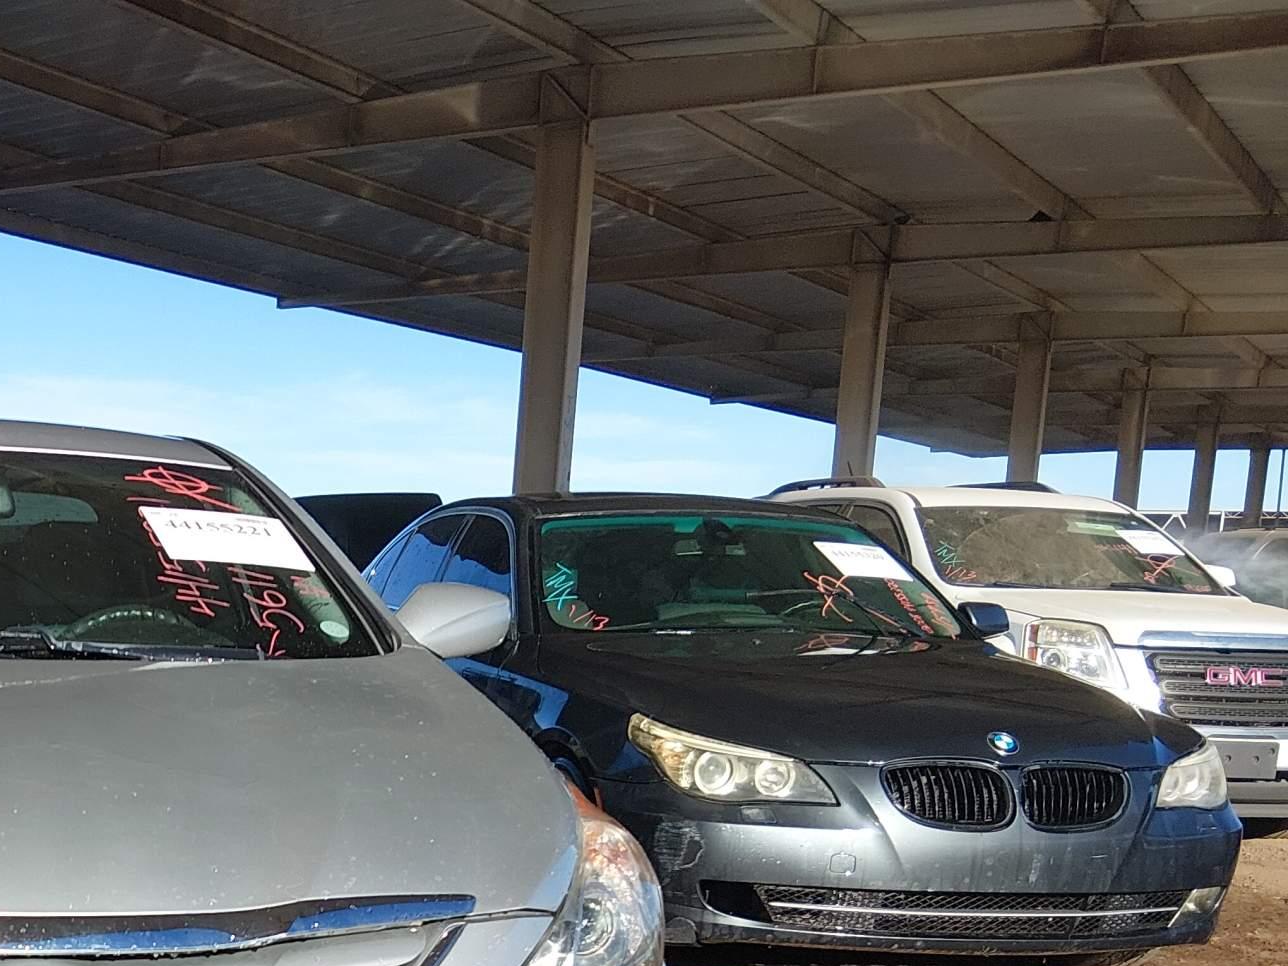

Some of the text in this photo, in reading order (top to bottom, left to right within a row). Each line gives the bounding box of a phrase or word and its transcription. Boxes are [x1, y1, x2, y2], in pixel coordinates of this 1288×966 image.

[164, 519, 272, 537] 44155221
[542, 562, 579, 611] TMX
[1206, 665, 1285, 688] GMC
